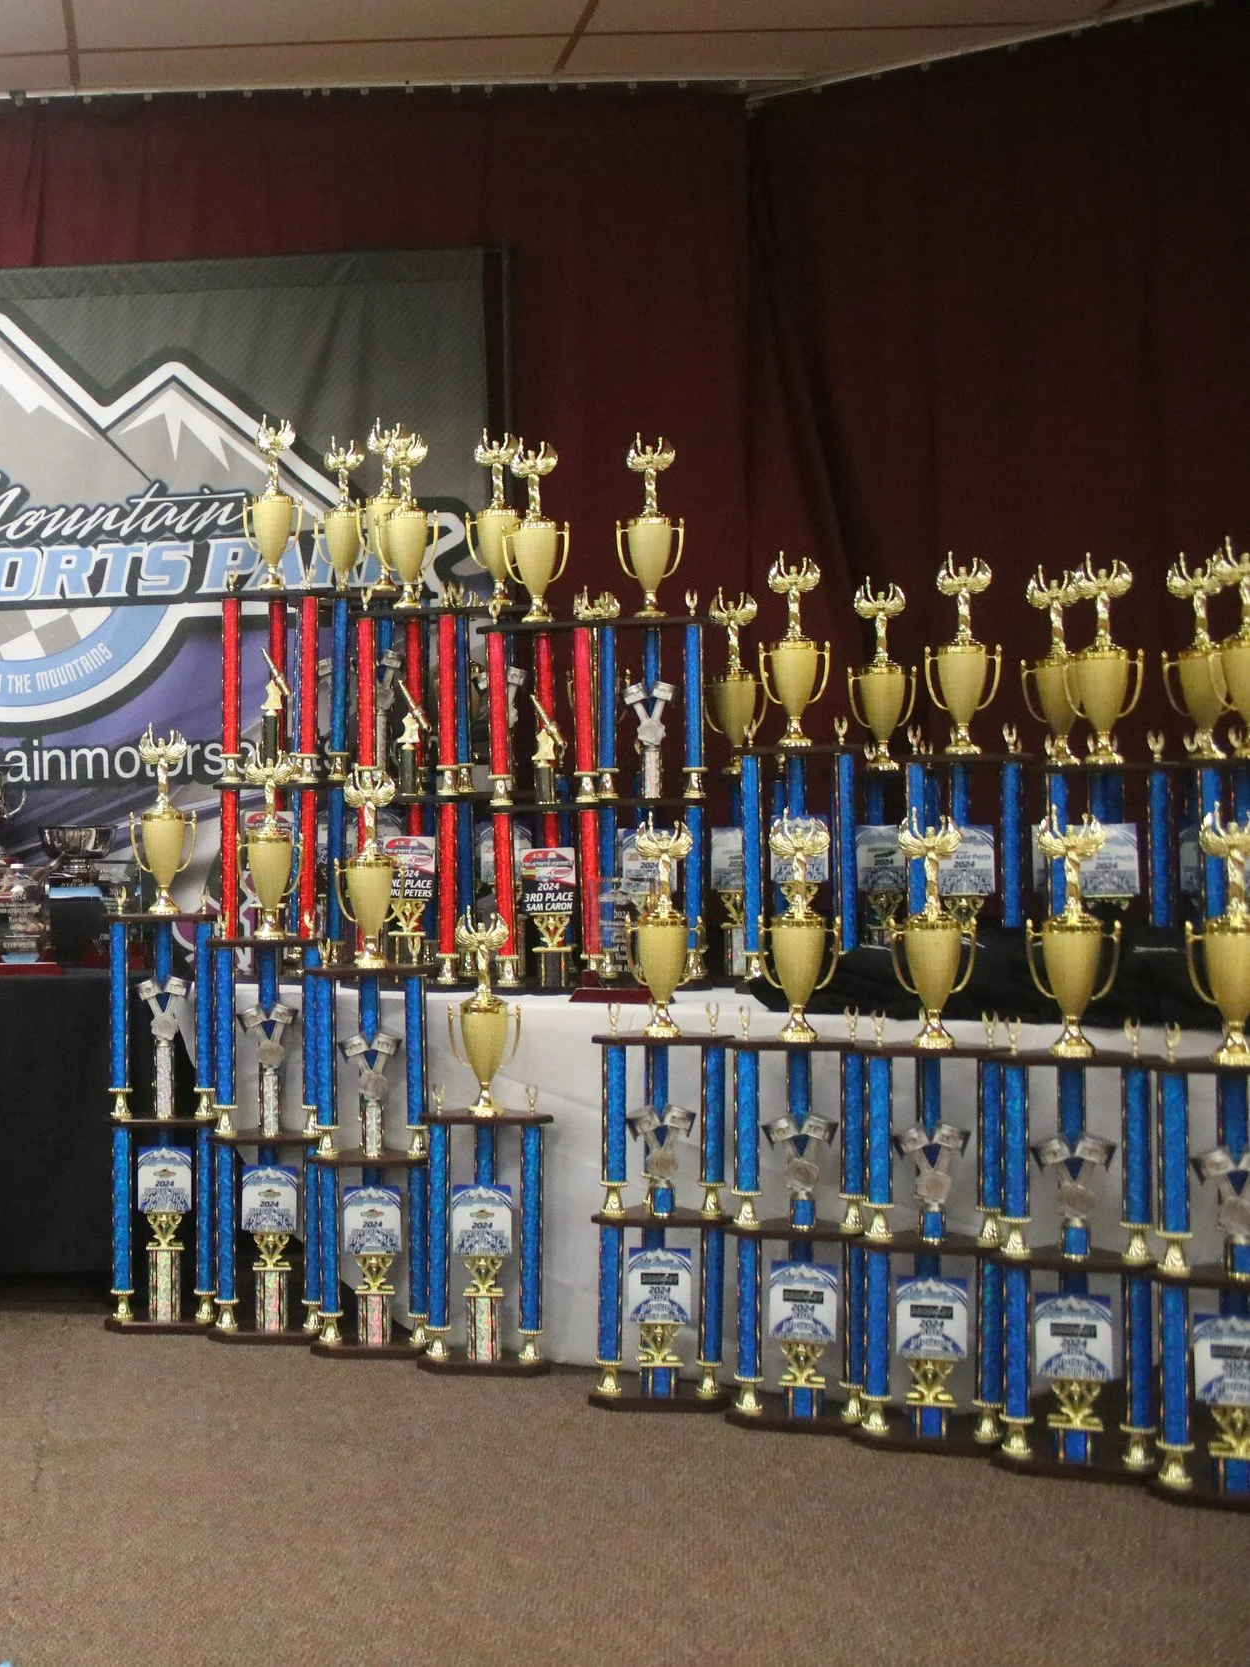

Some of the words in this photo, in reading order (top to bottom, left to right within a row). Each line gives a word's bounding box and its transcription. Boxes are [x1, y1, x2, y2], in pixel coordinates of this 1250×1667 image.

[6, 673, 32, 694] THE
[36, 641, 114, 692] MOUNTAINS
[953, 860, 975, 869] 2024
[405, 879, 433, 889] PLACE
[537, 882, 560, 891] 2024
[403, 888, 433, 897] PETERS
[523, 892, 543, 903] 3RD
[544, 891, 575, 902] PLACE
[525, 903, 544, 912] SAM
[545, 901, 573, 911] CARON
[259, 1200, 279, 1208] 2024
[362, 1220, 383, 1228] 2024
[471, 1221, 493, 1230] 2024
